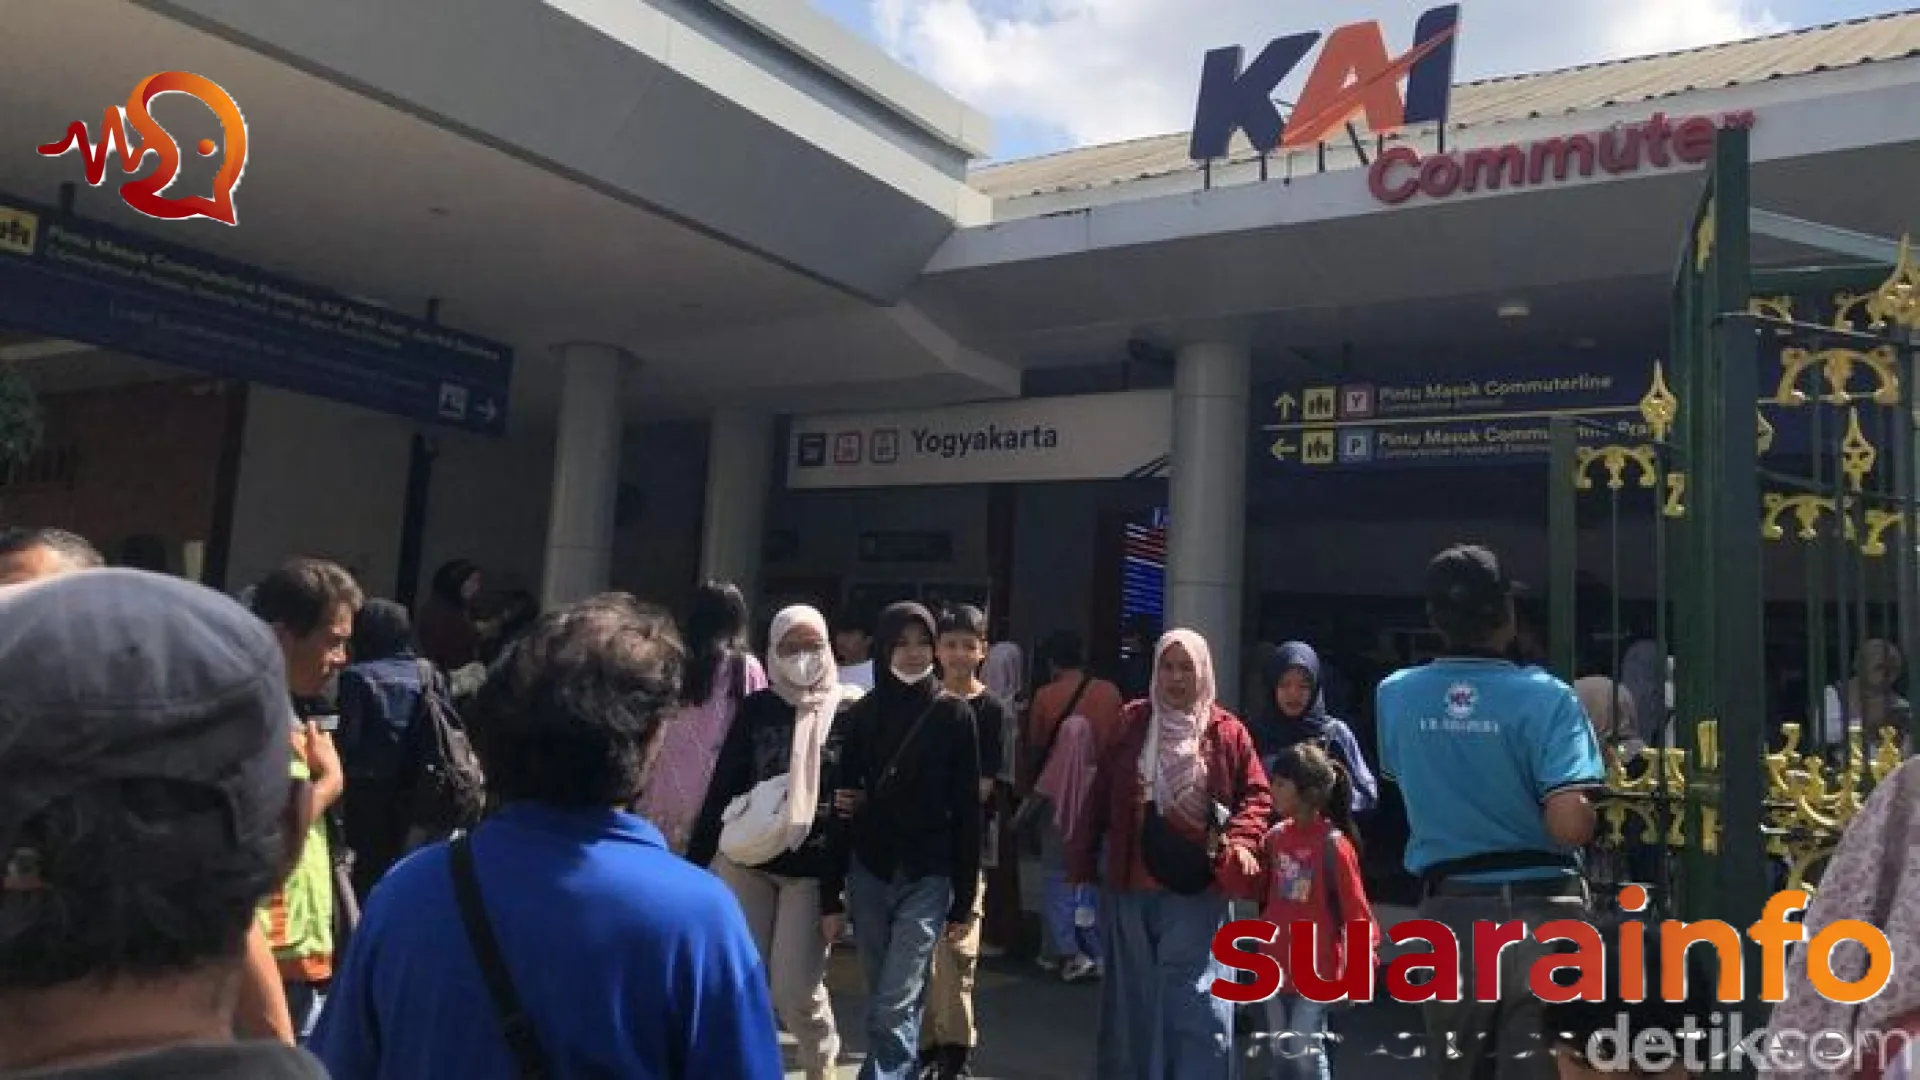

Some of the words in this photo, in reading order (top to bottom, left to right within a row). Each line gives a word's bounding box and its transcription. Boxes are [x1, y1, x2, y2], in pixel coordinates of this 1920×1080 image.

[1190, 3, 1460, 160] KAI
[1379, 385, 1421, 402] Pintu
[1426, 382, 1480, 397] Masuk
[1484, 374, 1611, 395] Commuterline
[911, 424, 1058, 459] Yogyakarta
[1426, 427, 1480, 445] Masuk
